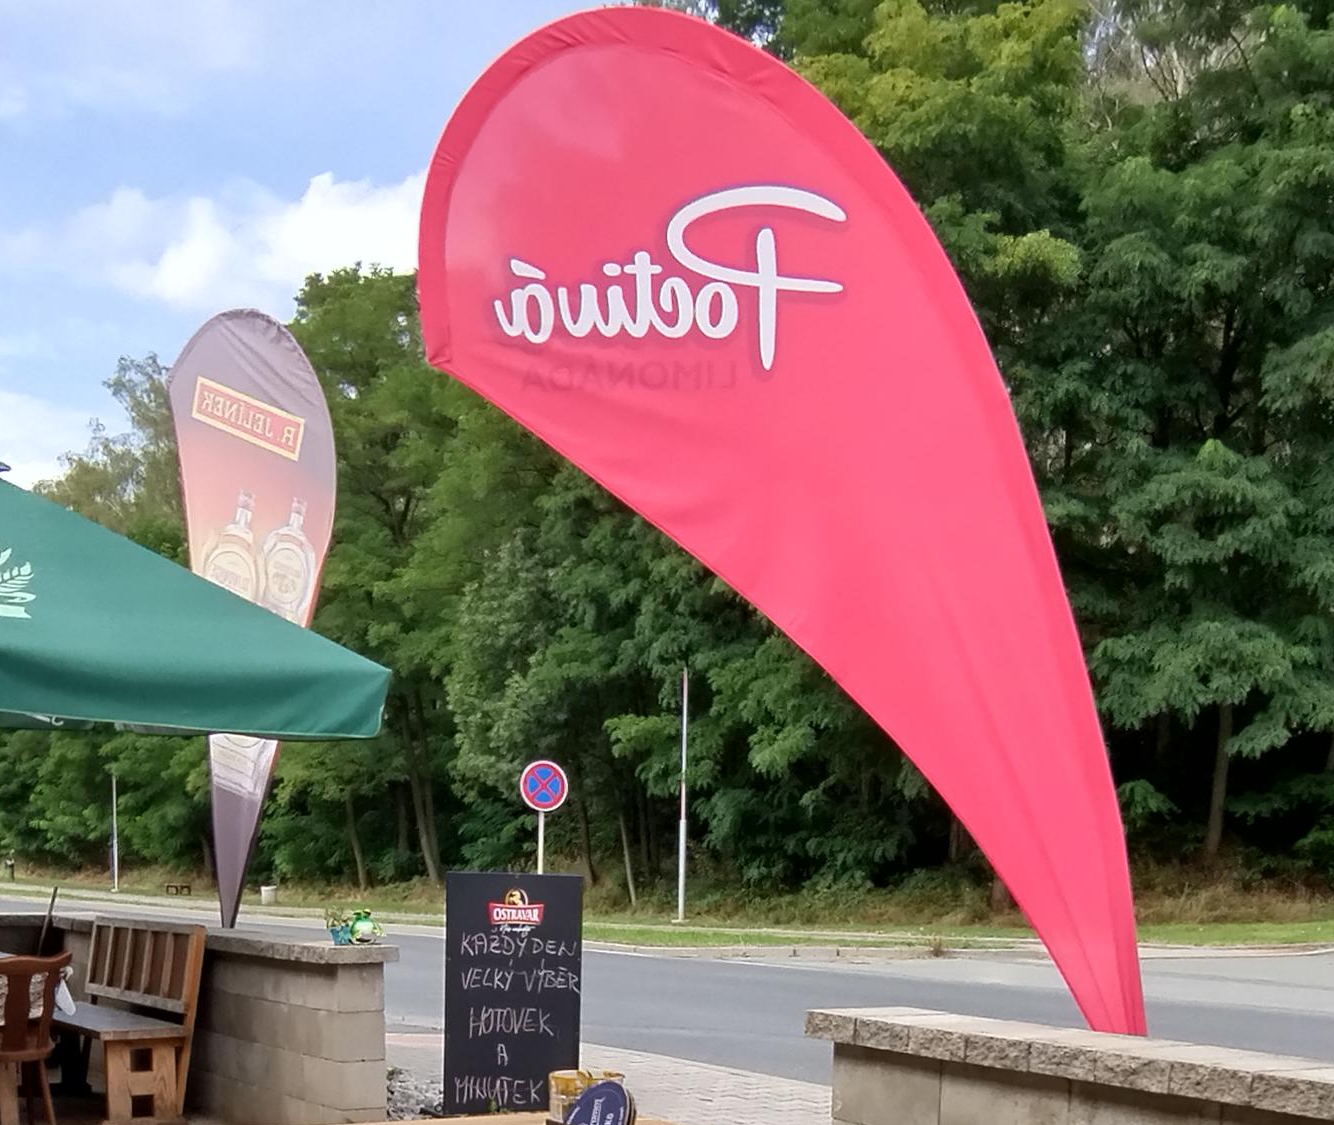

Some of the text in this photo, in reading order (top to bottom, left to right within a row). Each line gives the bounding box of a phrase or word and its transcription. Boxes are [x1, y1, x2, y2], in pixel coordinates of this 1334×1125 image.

[493, 907, 540, 922] OSTRAVAR
[531, 937, 577, 957] DEN
[462, 959, 515, 991] VELKÝ
[469, 1006, 554, 1039] HOTOVEK
[497, 1043, 508, 1067] A
[454, 1075, 543, 1106] MINUTEK
